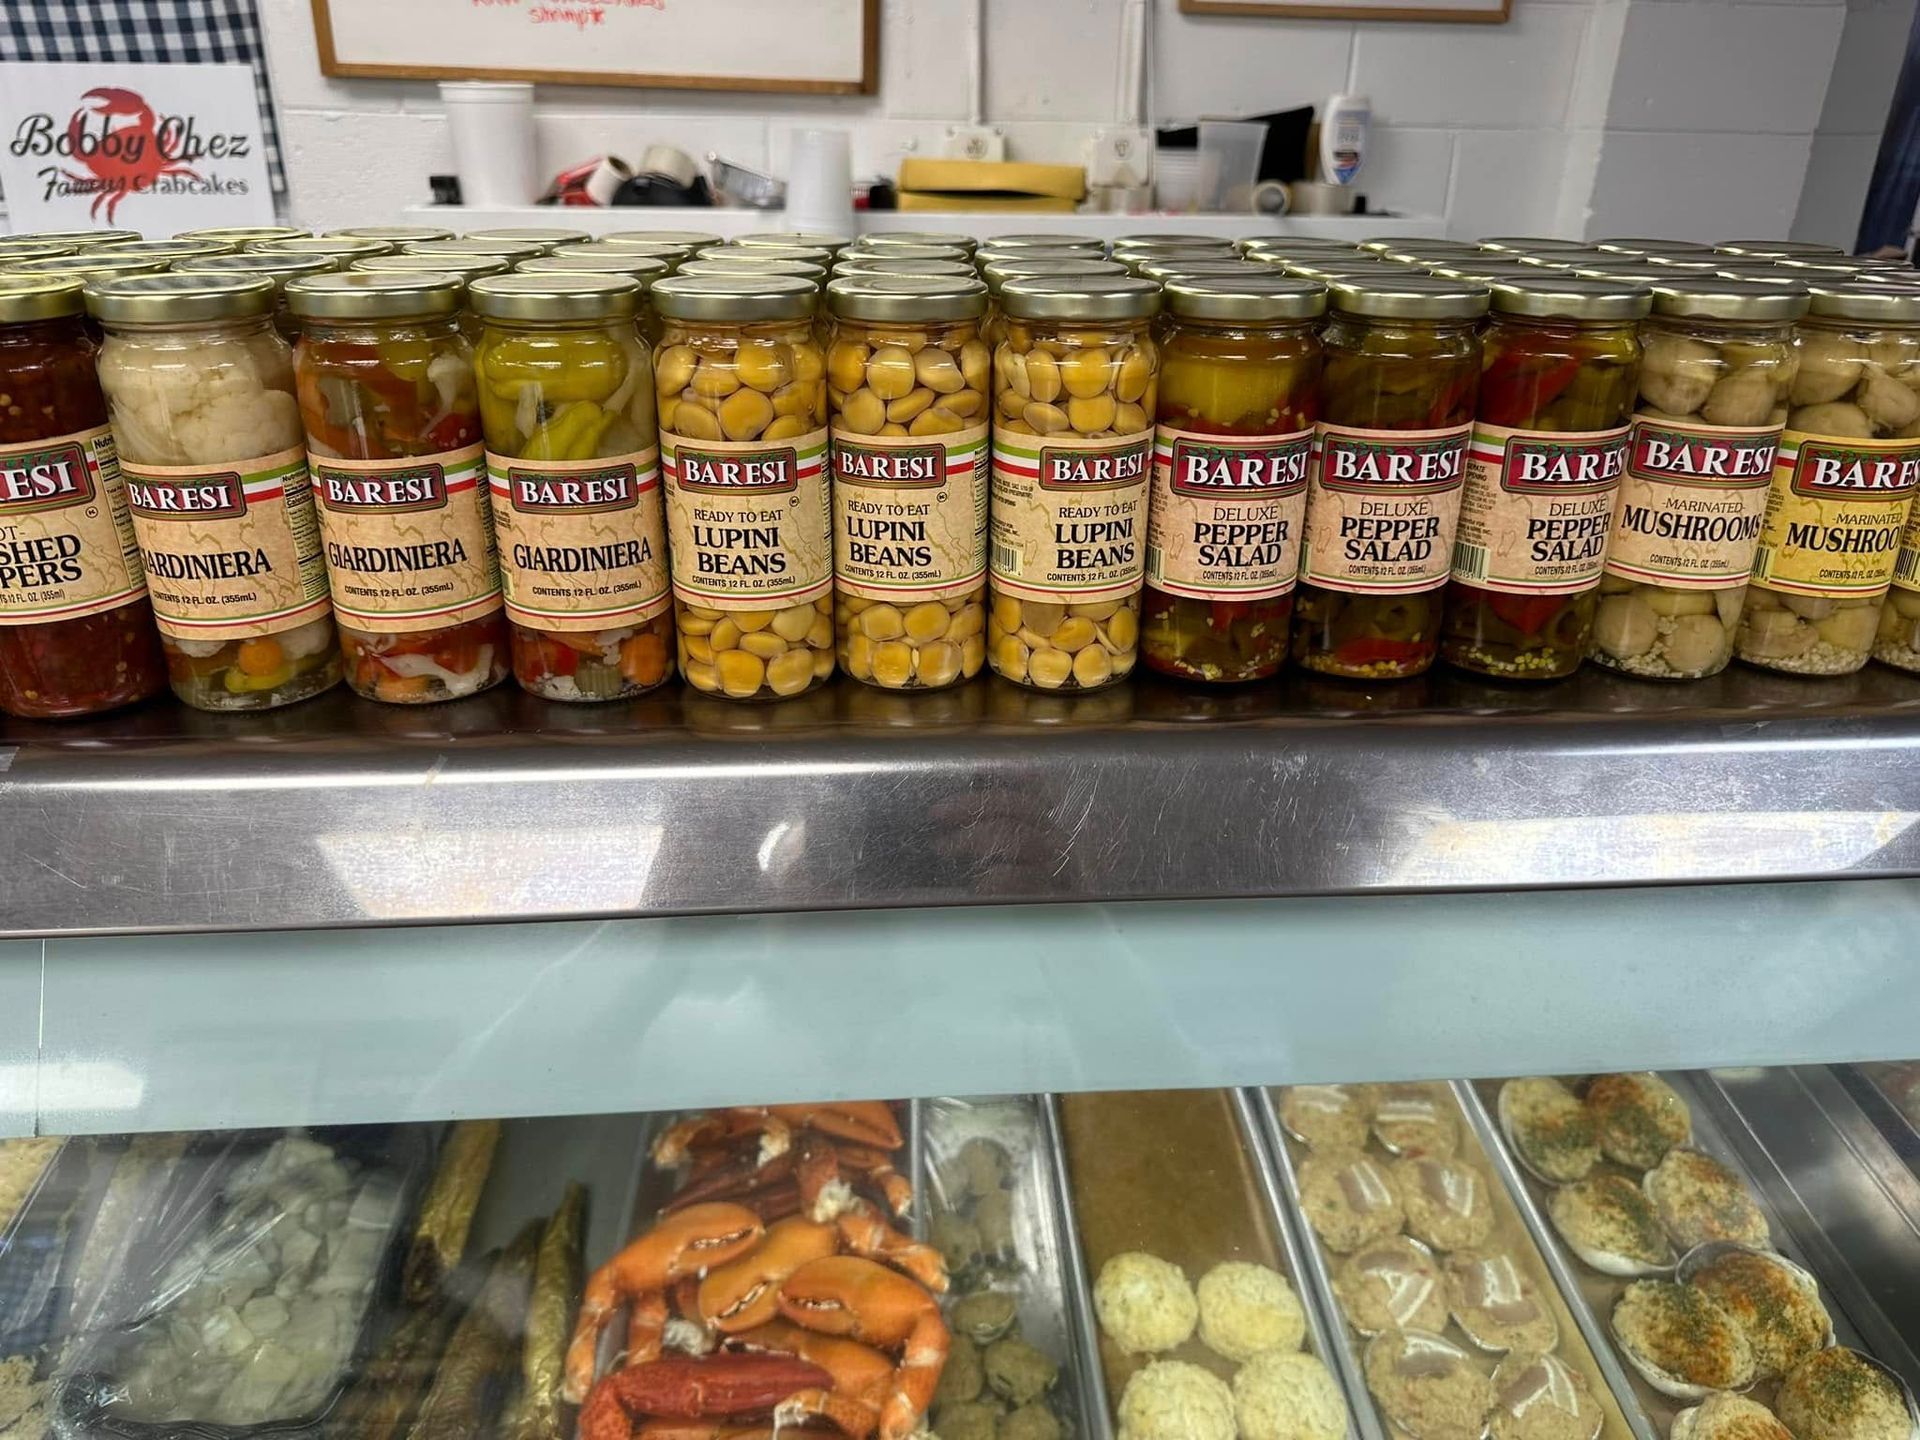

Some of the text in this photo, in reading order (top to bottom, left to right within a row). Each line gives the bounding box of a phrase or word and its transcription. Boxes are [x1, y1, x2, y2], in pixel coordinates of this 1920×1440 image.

[10, 114, 250, 163] Bobby Chez
[133, 174, 248, 195] Crabcakes
[841, 452, 936, 479] BARESI
[1052, 453, 1145, 481] BARESI
[1184, 452, 1308, 486] BARESI
[1334, 448, 1462, 482] BARESI
[1643, 440, 1776, 476] BARESI
[683, 458, 787, 485] BARESI
[128, 483, 233, 511] BARESI
[327, 477, 436, 504] BARESI
[519, 477, 630, 504] BARESI
[694, 509, 783, 522] READY TO EAT
[848, 500, 930, 516] READY TO EAT
[1059, 500, 1138, 518] READY TO EAT
[1213, 506, 1279, 521] DELUXE
[1360, 502, 1428, 516] DELUXE
[1549, 498, 1606, 517] DELUXE
[847, 516, 926, 541] LUPINI
[1055, 517, 1133, 544] LUPINI
[1193, 521, 1289, 545] PEPPER
[1341, 516, 1440, 540] PEPPER
[1527, 512, 1611, 541] PEPPER
[1622, 504, 1762, 542] MUSHROOMS
[693, 525, 779, 549] LUPINI
[1531, 536, 1604, 561] SALAD
[329, 538, 467, 572] GIARDINIERA
[514, 537, 652, 572] GIARDINIERA
[850, 541, 932, 567] BEANS
[1056, 542, 1134, 569] BEANS
[1198, 543, 1281, 567] SALAD
[1345, 539, 1431, 562] SALAD
[1650, 554, 1682, 568] CONTENTS
[698, 551, 786, 575] BEANS
[845, 564, 874, 577] CONTENTS
[912, 569, 941, 580] (355mL)
[1349, 565, 1379, 574] CONTENTS
[693, 575, 726, 588] CONTENTS
[728, 580, 738, 588] 12
[1047, 573, 1085, 582] CONTENTS
[1088, 573, 1097, 581] 12
[1203, 571, 1233, 580] CONTENTS
[222, 592, 256, 605] (355mL)
[345, 585, 378, 597] CONTENTS
[422, 582, 454, 596] (355mL)
[533, 586, 571, 597] CONTENTS
